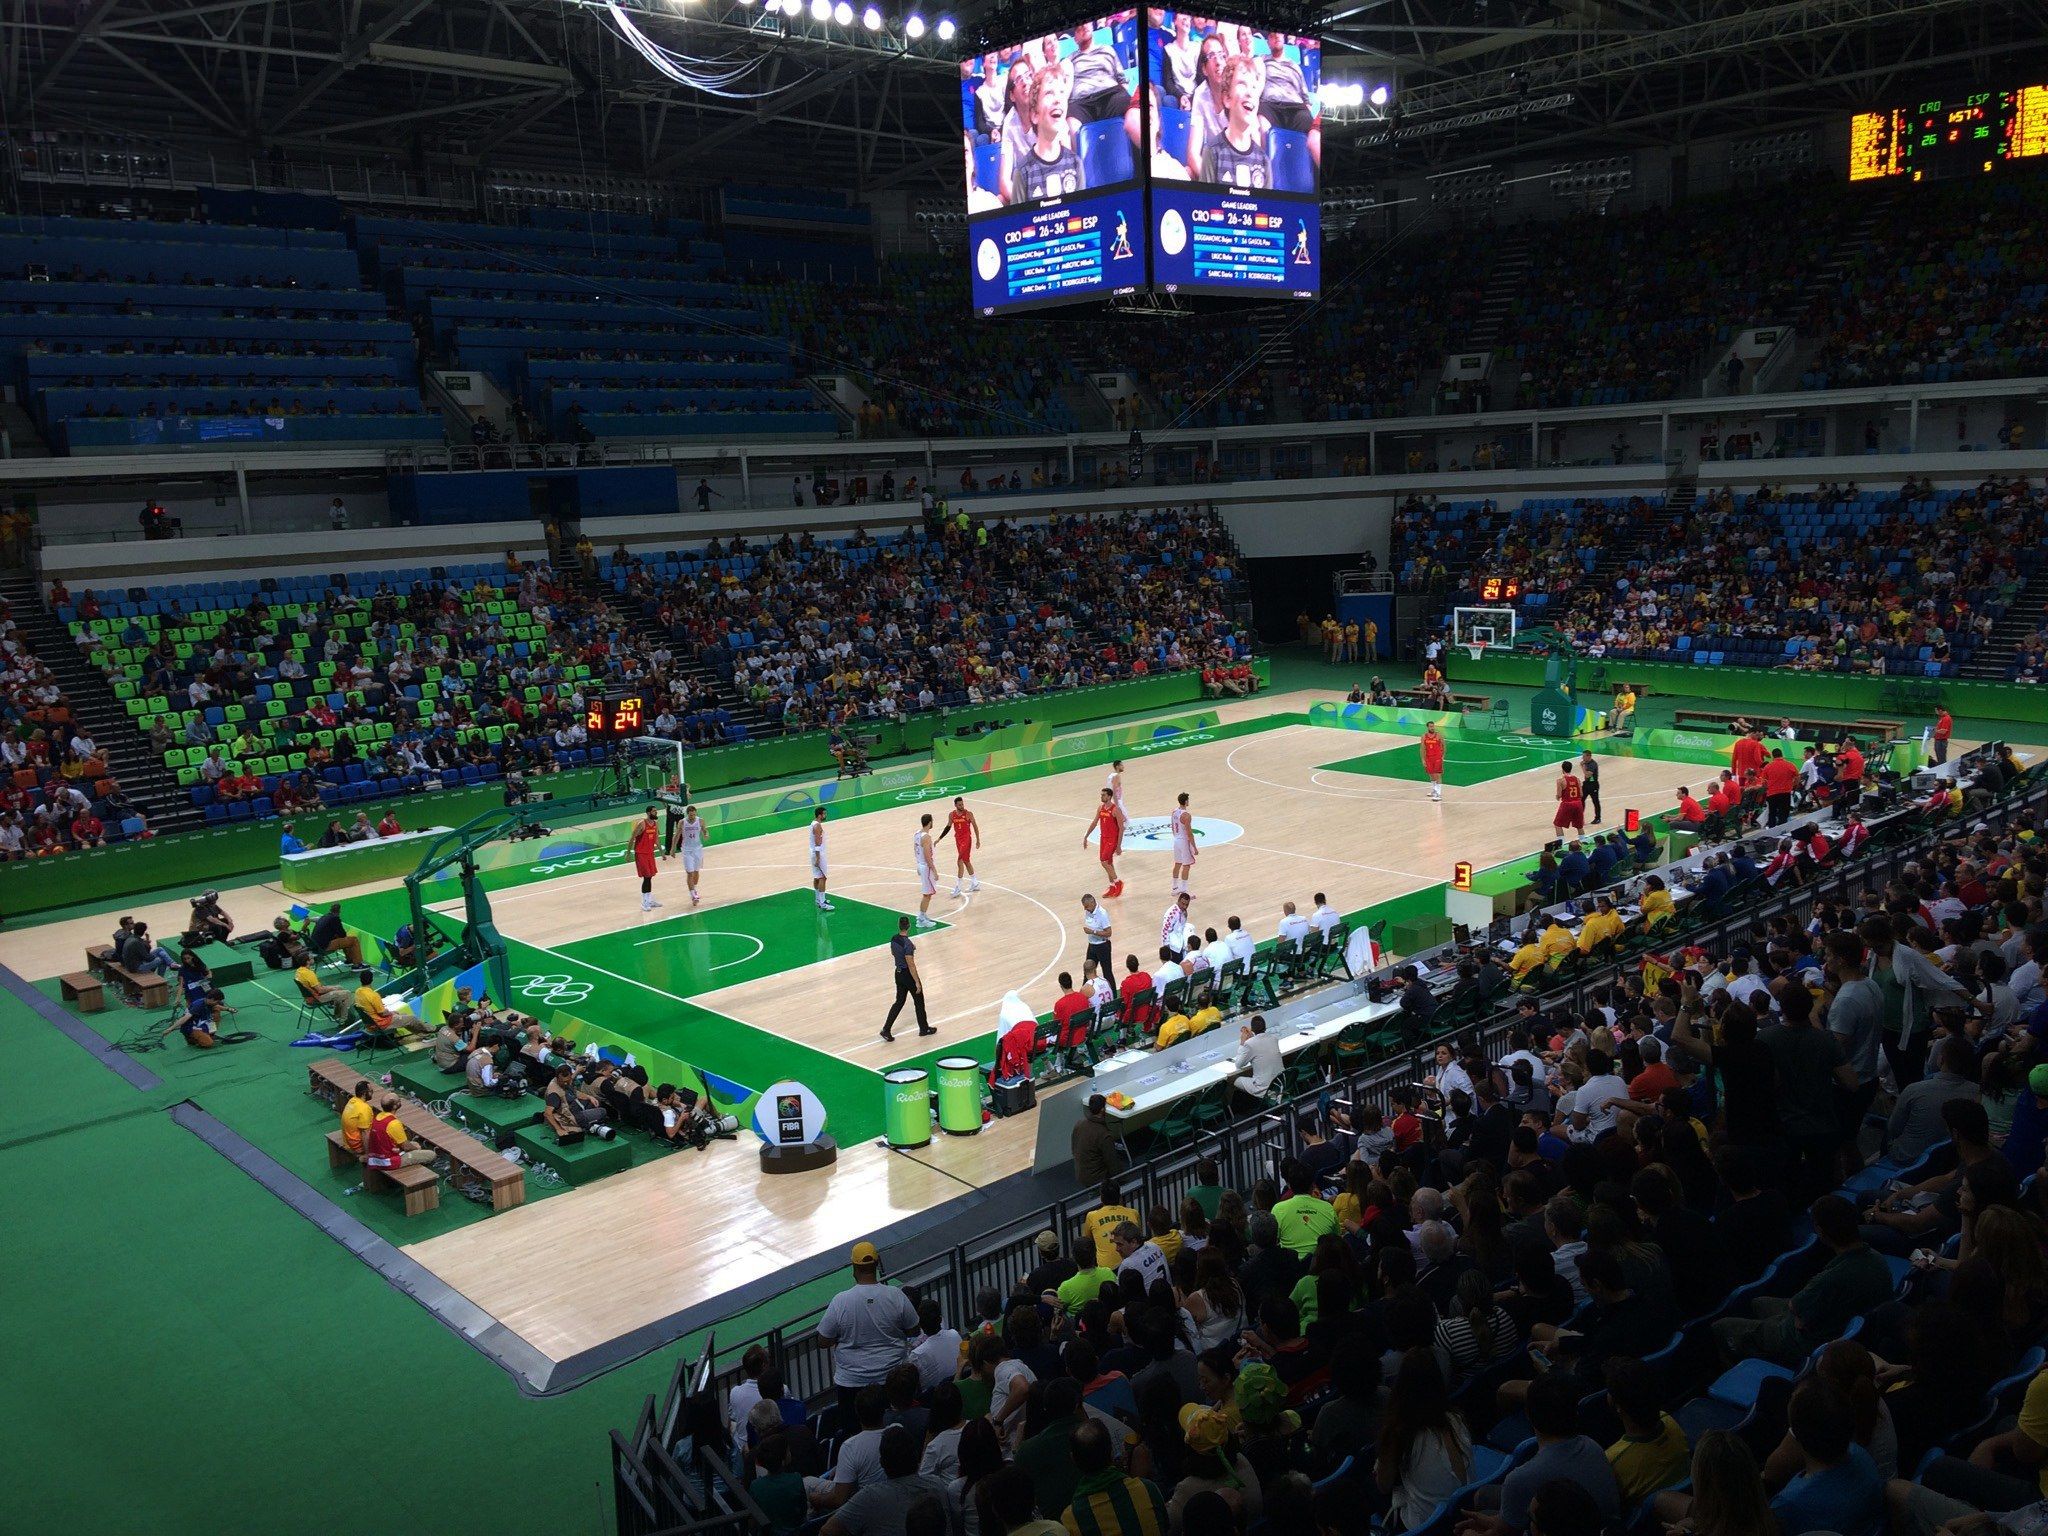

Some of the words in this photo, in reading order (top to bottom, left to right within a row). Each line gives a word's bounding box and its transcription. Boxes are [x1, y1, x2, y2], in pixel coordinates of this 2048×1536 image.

[1968, 93, 1990, 106] ESP
[1920, 101, 1941, 114] CRO
[1949, 130, 1958, 140] 2
[1974, 126, 1990, 138] 36
[1922, 134, 1938, 146] 26
[1984, 161, 1992, 172] 5
[1222, 201, 1236, 210] GAME
[1237, 202, 1258, 212] LEADERS
[1033, 212, 1048, 223] GAME
[1048, 210, 1070, 220] LEADERS
[1192, 210, 1210, 222] CRO
[1268, 216, 1282, 228] ESP
[1005, 231, 1021, 244] CRO
[1082, 216, 1098, 229] ESP
[1484, 586, 1498, 597] 24
[1506, 585, 1517, 596] 24
[588, 712, 602, 729] 24
[615, 712, 638, 730] 24
[1674, 734, 1712, 747] Rio2016
[881, 772, 913, 786] Rio2016
[1570, 786, 1578, 798] 23
[1457, 864, 1470, 887] 3
[1098, 991, 1112, 1004] 33
[938, 1076, 972, 1087] Rio2016
[782, 1120, 800, 1131] FIBA
